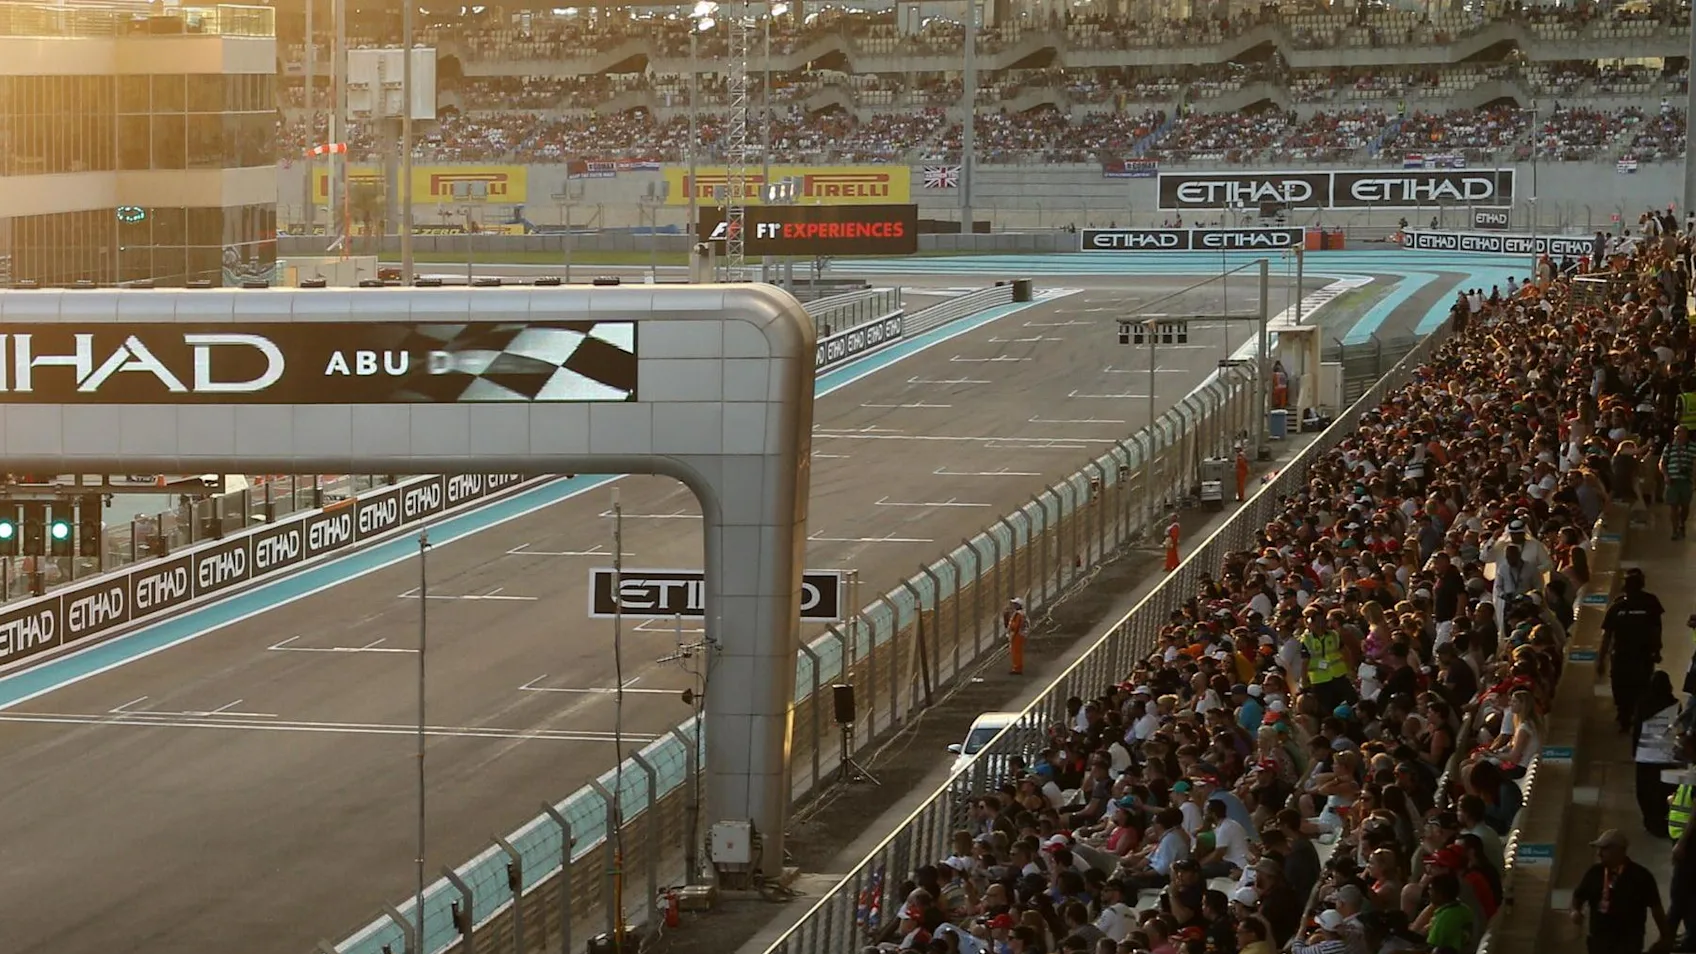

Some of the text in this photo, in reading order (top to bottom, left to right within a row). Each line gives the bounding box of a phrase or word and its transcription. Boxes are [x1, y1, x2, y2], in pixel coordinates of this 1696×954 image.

[430, 173, 508, 197] PILI
[803, 173, 891, 197] PIRELLI
[1177, 180, 1312, 203] ETIHAD
[1351, 177, 1495, 200] ETIHAD
[783, 221, 904, 238] EXPERIENCES
[1475, 213, 1507, 224] ETIHAD
[1093, 234, 1178, 246] ETIHAD
[1203, 233, 1291, 246] ETIHAD
[1419, 236, 1456, 248] ETIHAD
[1462, 237, 1499, 250] ETIHAD
[1552, 240, 1592, 253] ETIHAD
[325, 350, 409, 376] ABU
[405, 483, 440, 517] ETIHAD
[359, 498, 397, 532] ETIHAD
[310, 513, 351, 550] ETIHAD
[256, 530, 300, 567] ETIHAD
[199, 547, 246, 587] ETIHAD
[137, 566, 187, 609] ETIHAD
[69, 588, 123, 632] ETIHAD
